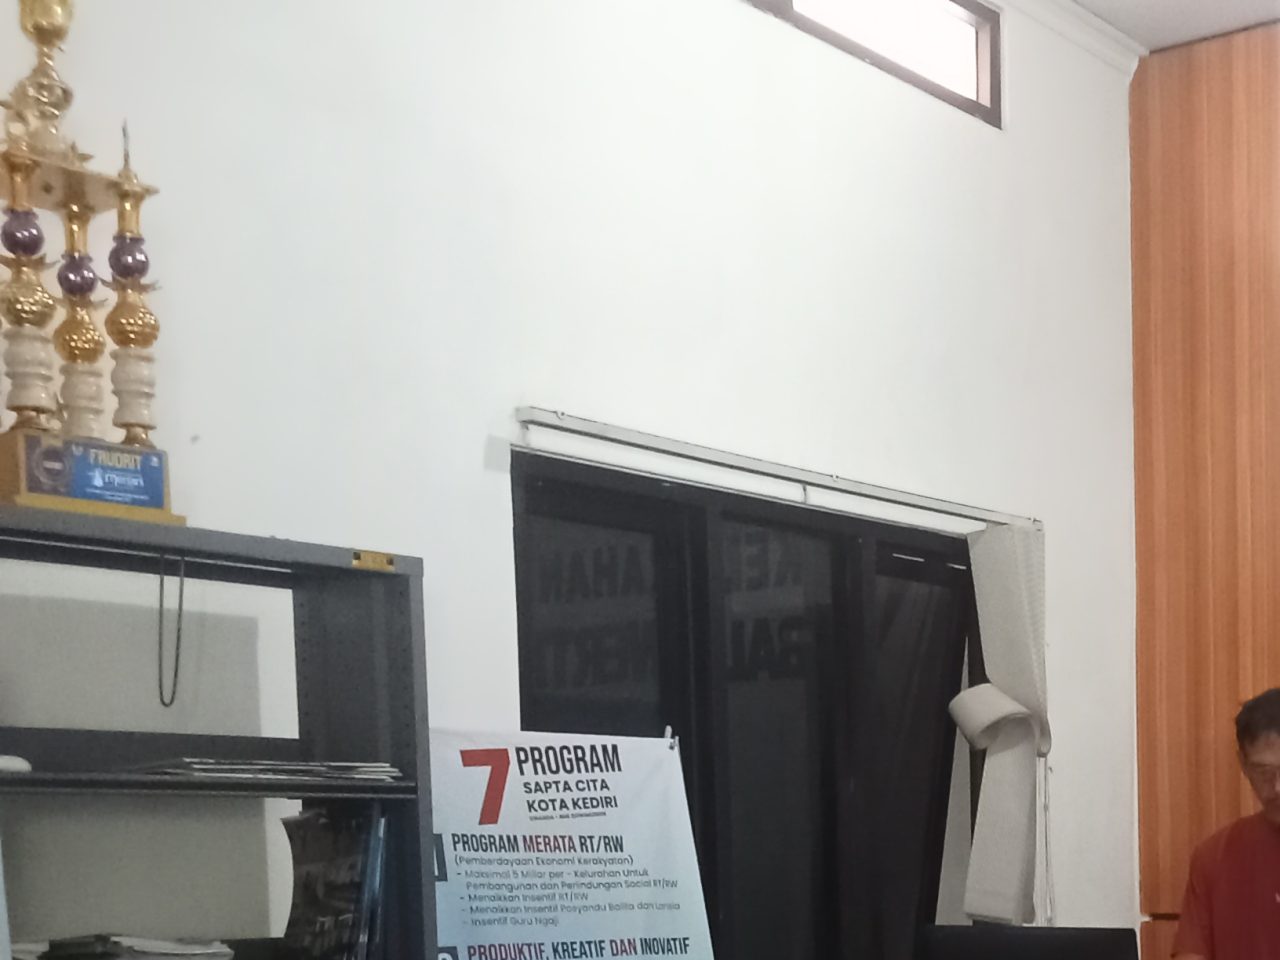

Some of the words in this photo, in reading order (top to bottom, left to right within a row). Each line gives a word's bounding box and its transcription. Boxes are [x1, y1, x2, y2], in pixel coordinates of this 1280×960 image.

[459, 748, 510, 825] 7
[516, 744, 622, 776] PROGRAM
[523, 780, 572, 795] SAPTA
[575, 779, 610, 792] CITA
[527, 798, 569, 814] KOTA
[572, 795, 618, 811] KEDIRI
[451, 833, 520, 853] PROGRAM
[523, 834, 576, 852] MERATA
[579, 834, 624, 852] RT/RW
[536, 857, 575, 865] Ekonomi
[574, 869, 621, 878] Kelurahan
[623, 868, 648, 877] Untuk
[466, 881, 538, 893] Pembangunan
[540, 881, 559, 890] dan
[552, 939, 606, 960] KREATIF
[609, 938, 637, 957] DAN
[640, 937, 690, 956] INOVATIF
